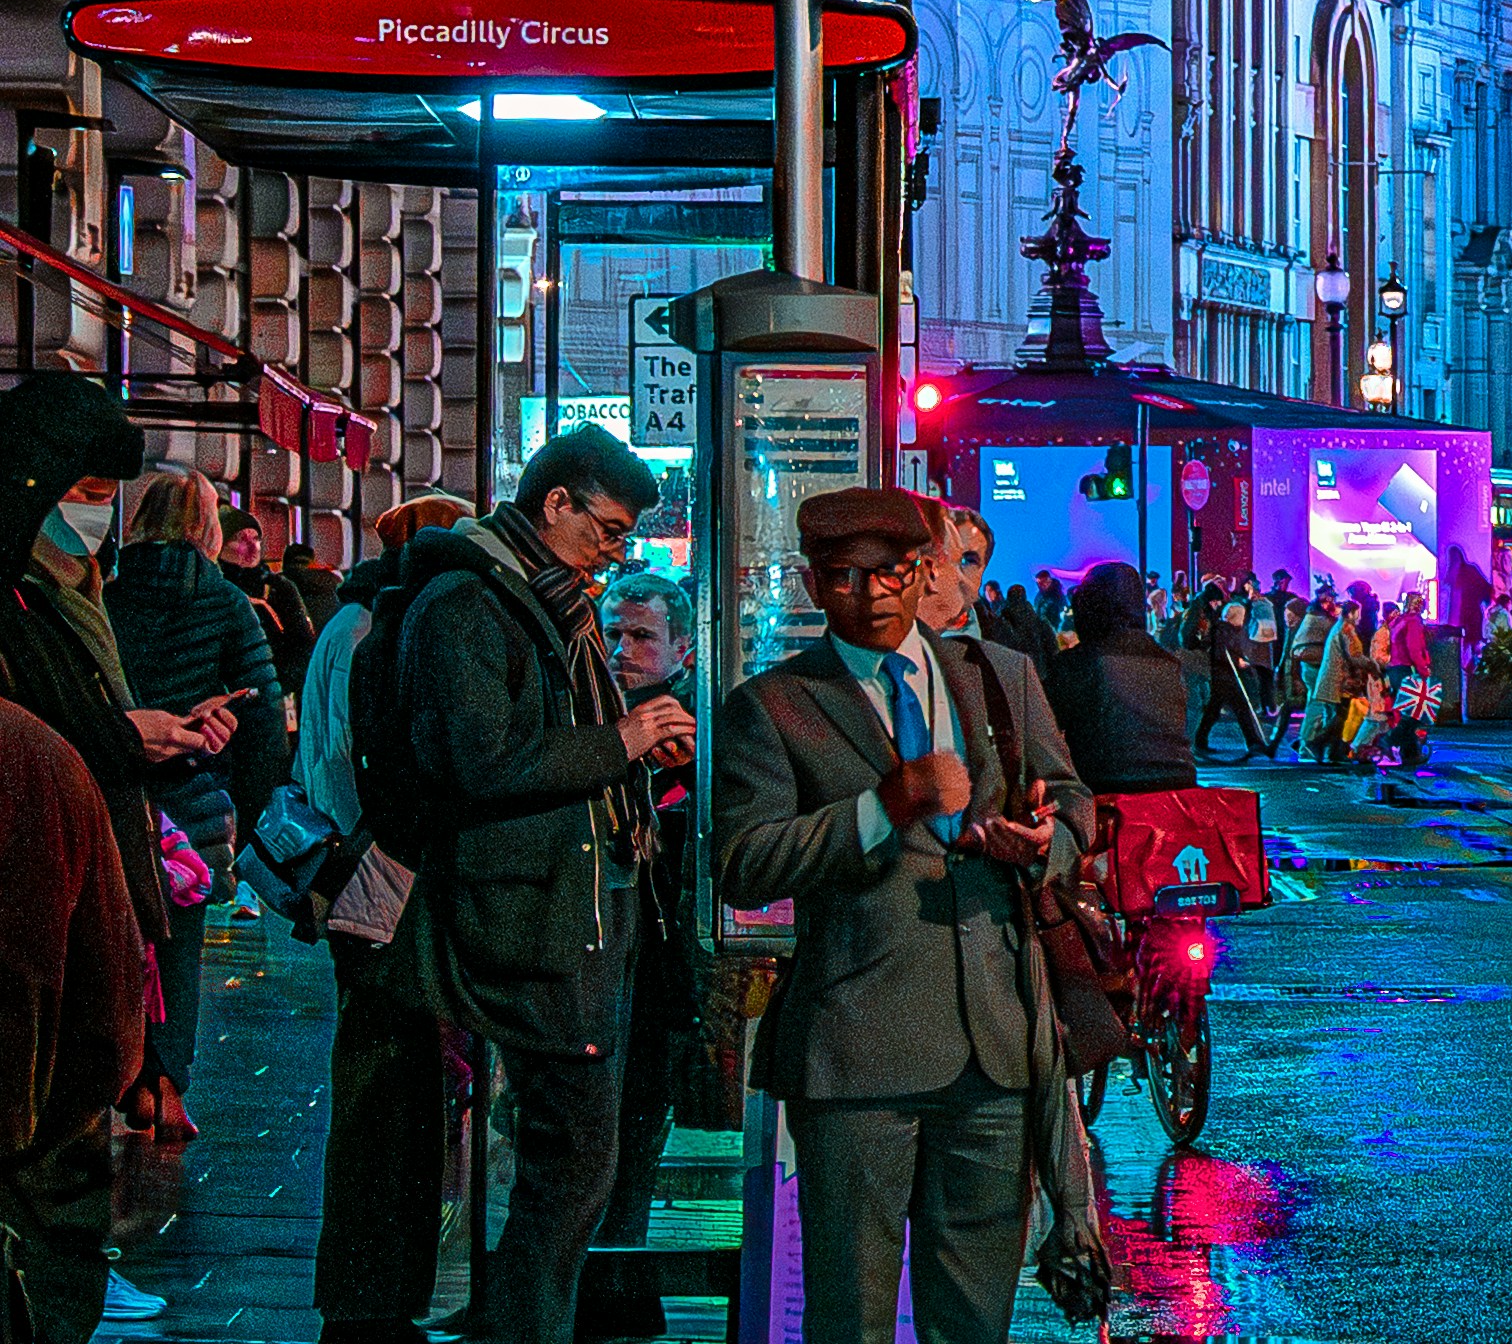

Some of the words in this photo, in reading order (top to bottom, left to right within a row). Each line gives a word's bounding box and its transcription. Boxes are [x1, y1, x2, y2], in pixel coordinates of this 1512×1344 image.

[378, 18, 513, 50] Piccadilly
[521, 20, 608, 47] Circus
[643, 355, 692, 377] The
[562, 404, 630, 420] OBACCO
[645, 411, 686, 432] A4
[1260, 478, 1291, 496] intel
